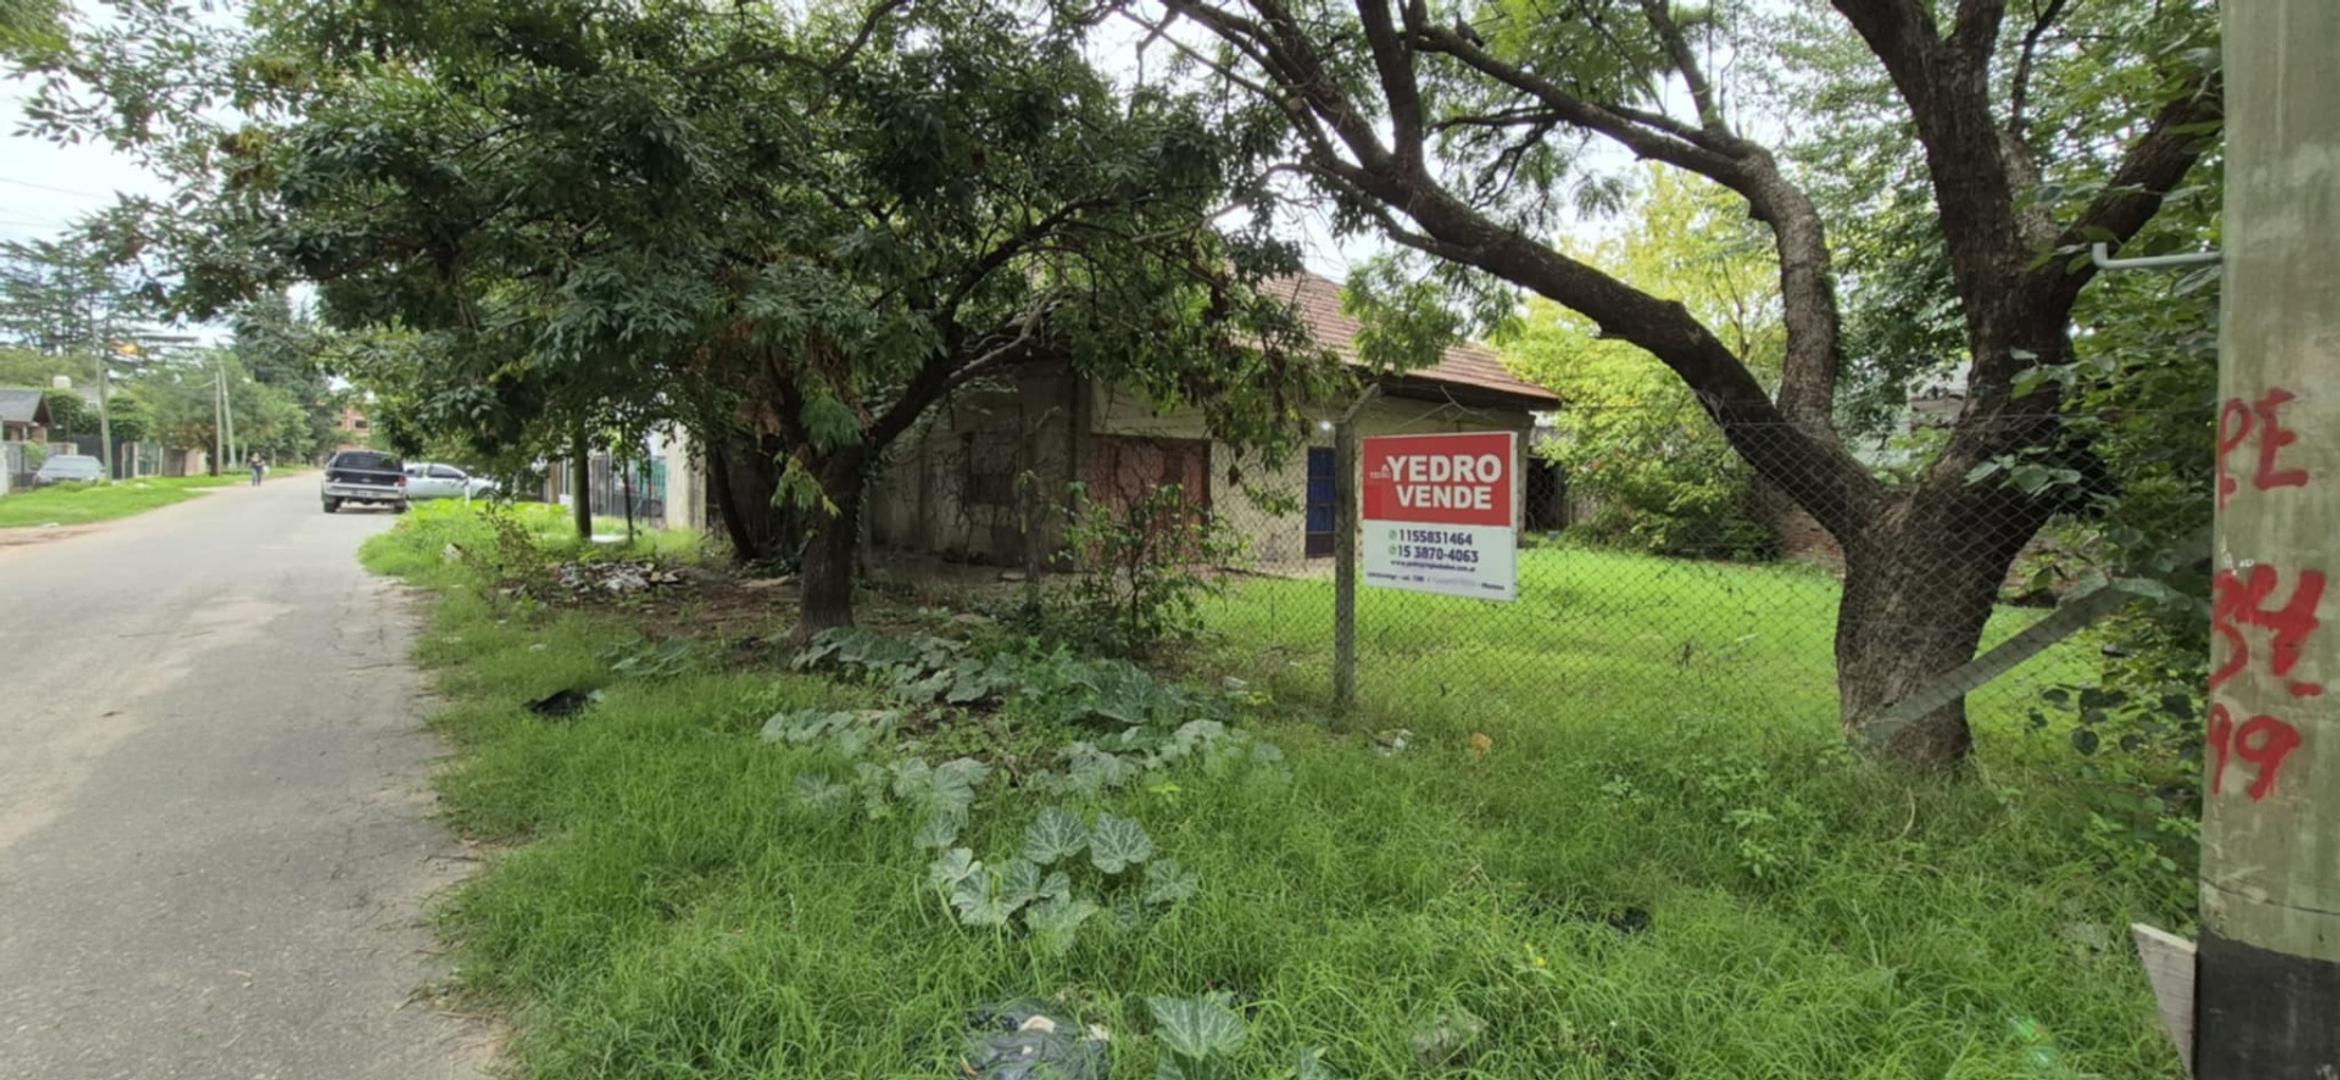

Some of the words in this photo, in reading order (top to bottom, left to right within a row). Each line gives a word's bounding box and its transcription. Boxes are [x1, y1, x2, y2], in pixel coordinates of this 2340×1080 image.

[1387, 454, 1502, 482] YEDRO
[1396, 485, 1492, 509] VENDE
[1400, 529, 1472, 545] 1155831464
[1398, 546, 1411, 558] 15
[1414, 547, 1479, 563] 3870-4063
